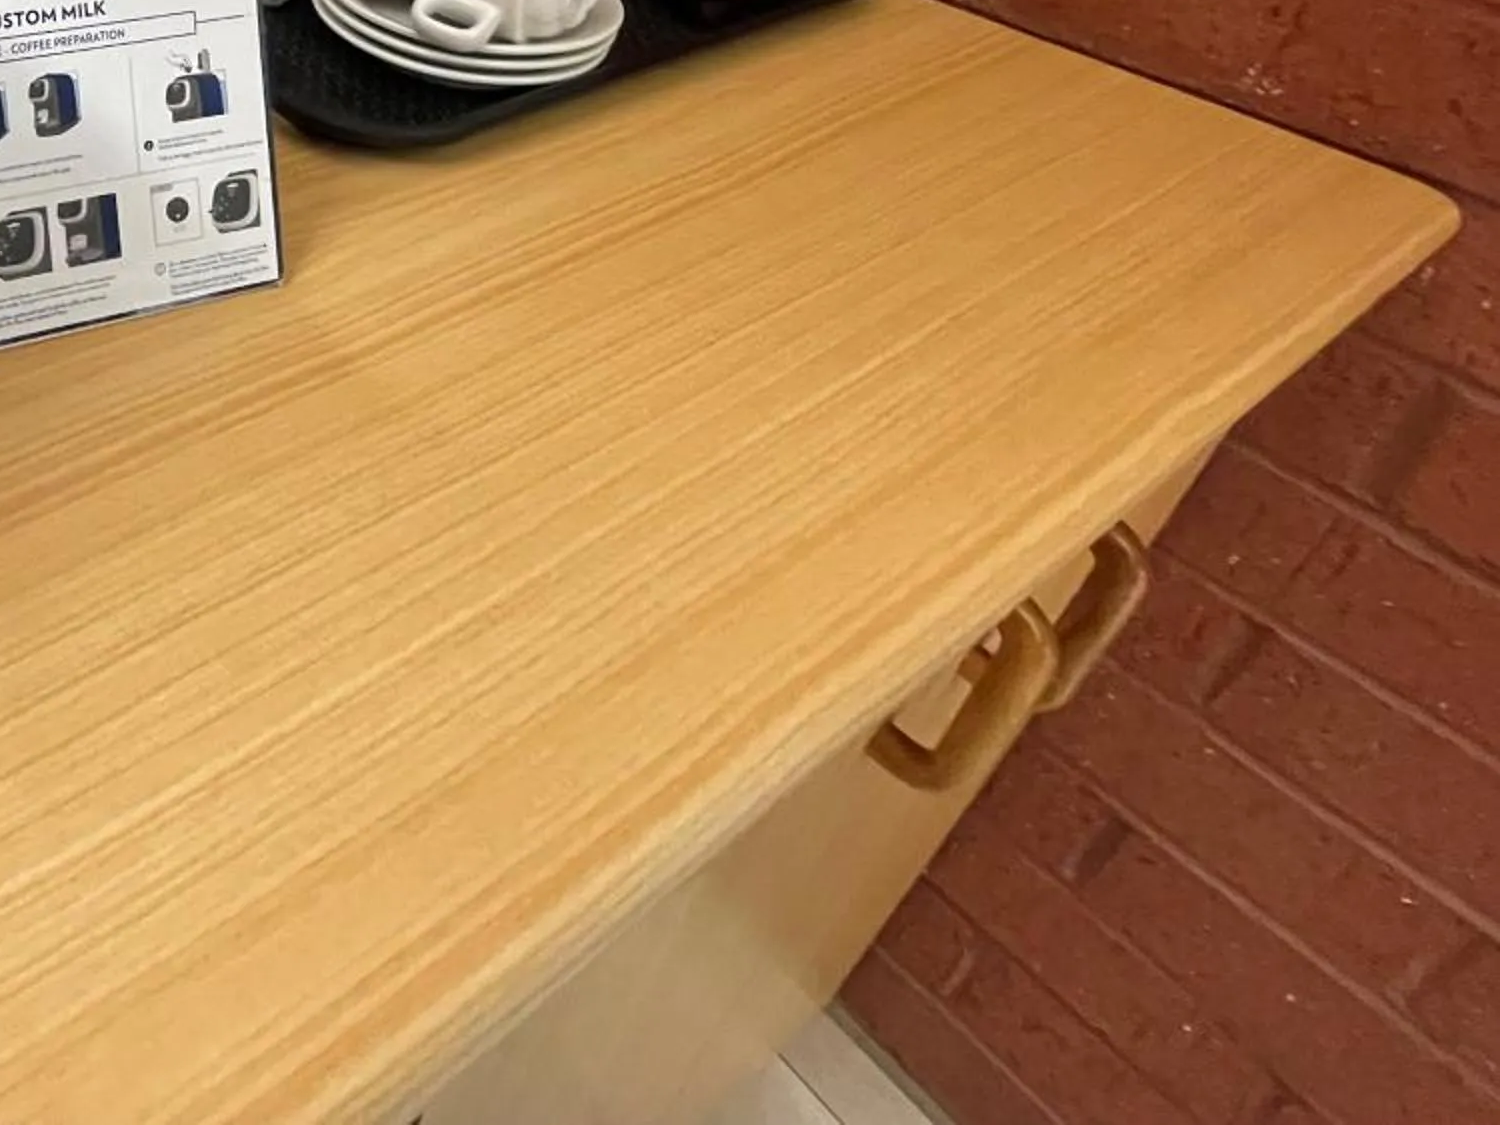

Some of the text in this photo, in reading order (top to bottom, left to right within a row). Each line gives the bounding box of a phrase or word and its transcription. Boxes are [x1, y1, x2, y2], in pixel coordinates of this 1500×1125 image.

[61, 0, 106, 20] MILK
[10, 37, 53, 55] COFFEE
[53, 28, 125, 48] PREPARATION
